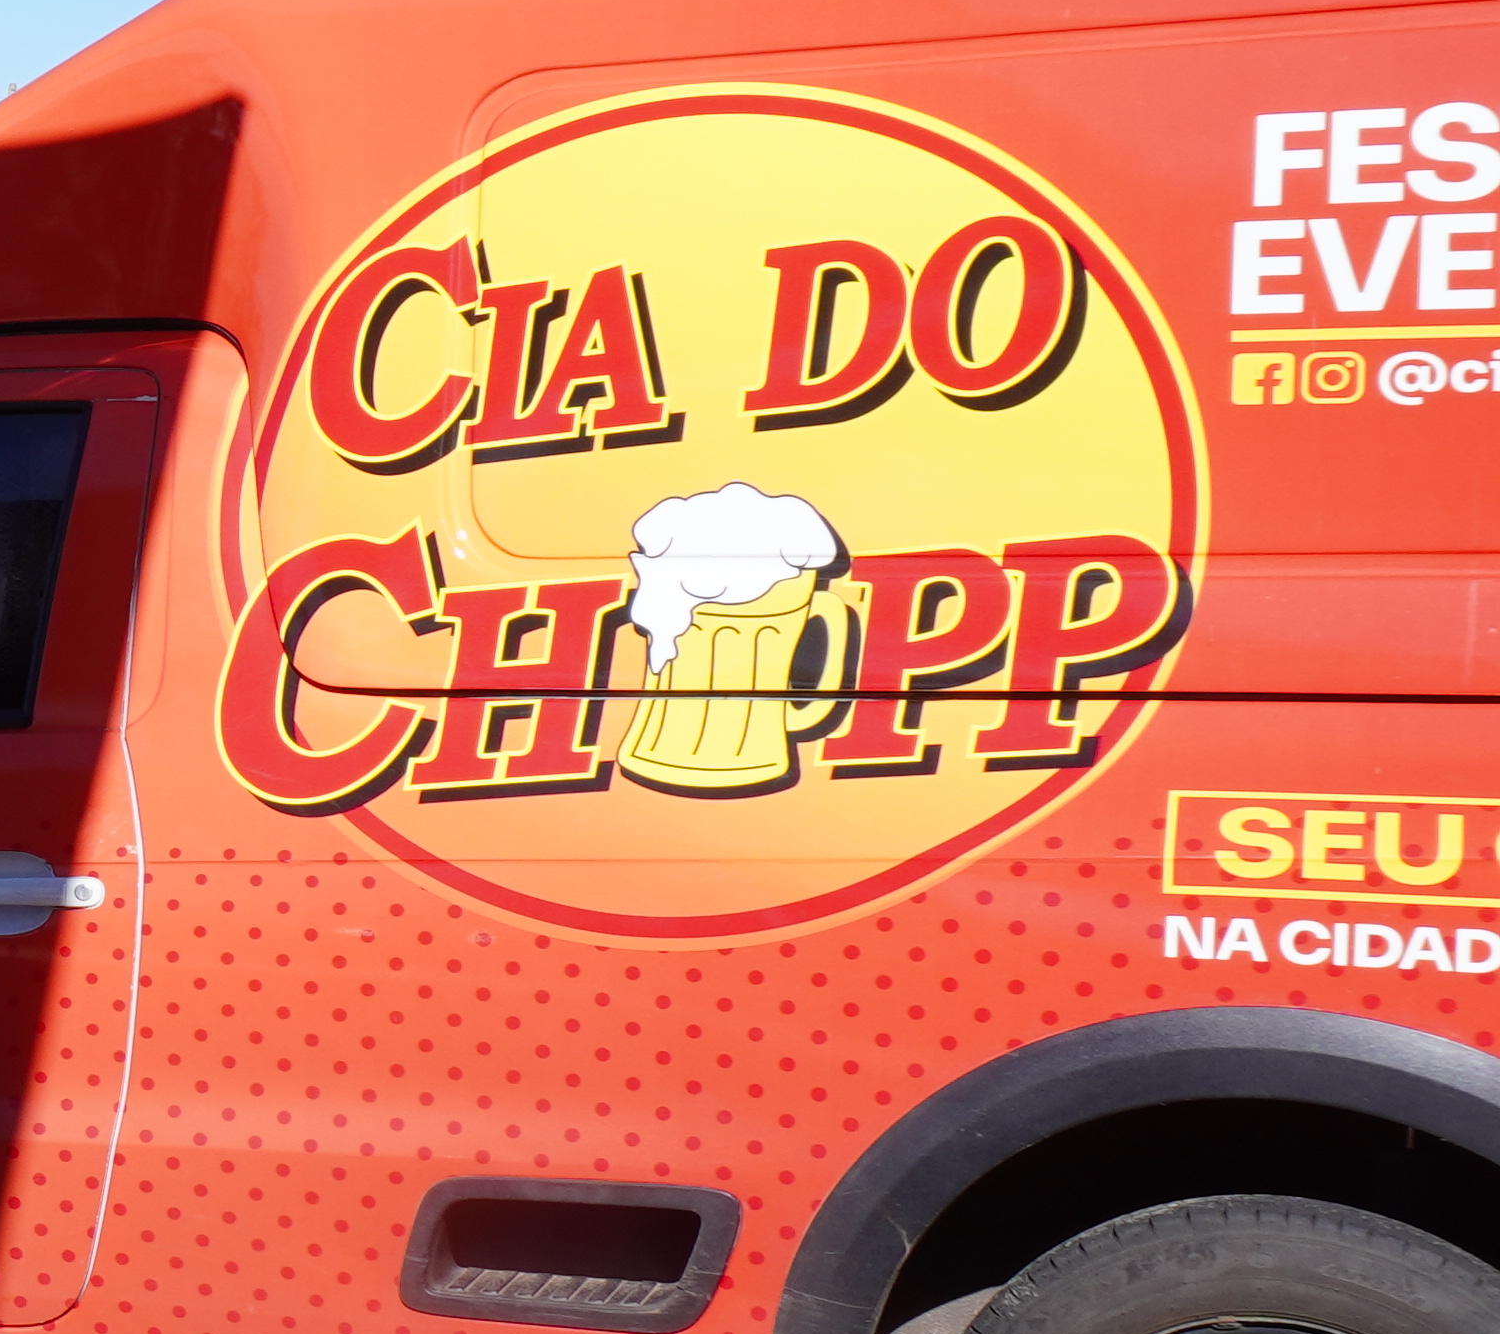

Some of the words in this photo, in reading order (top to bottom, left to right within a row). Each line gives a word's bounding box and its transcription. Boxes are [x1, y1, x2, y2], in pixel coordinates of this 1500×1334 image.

[1253, 101, 1500, 207] FES
[1230, 212, 1498, 315] EVE
[306, 233, 685, 476] CIA
[743, 214, 1088, 433] DO
[1214, 805, 1465, 886] SEU
[1164, 914, 1269, 963] NA
[1279, 919, 1500, 974] CIDAD
